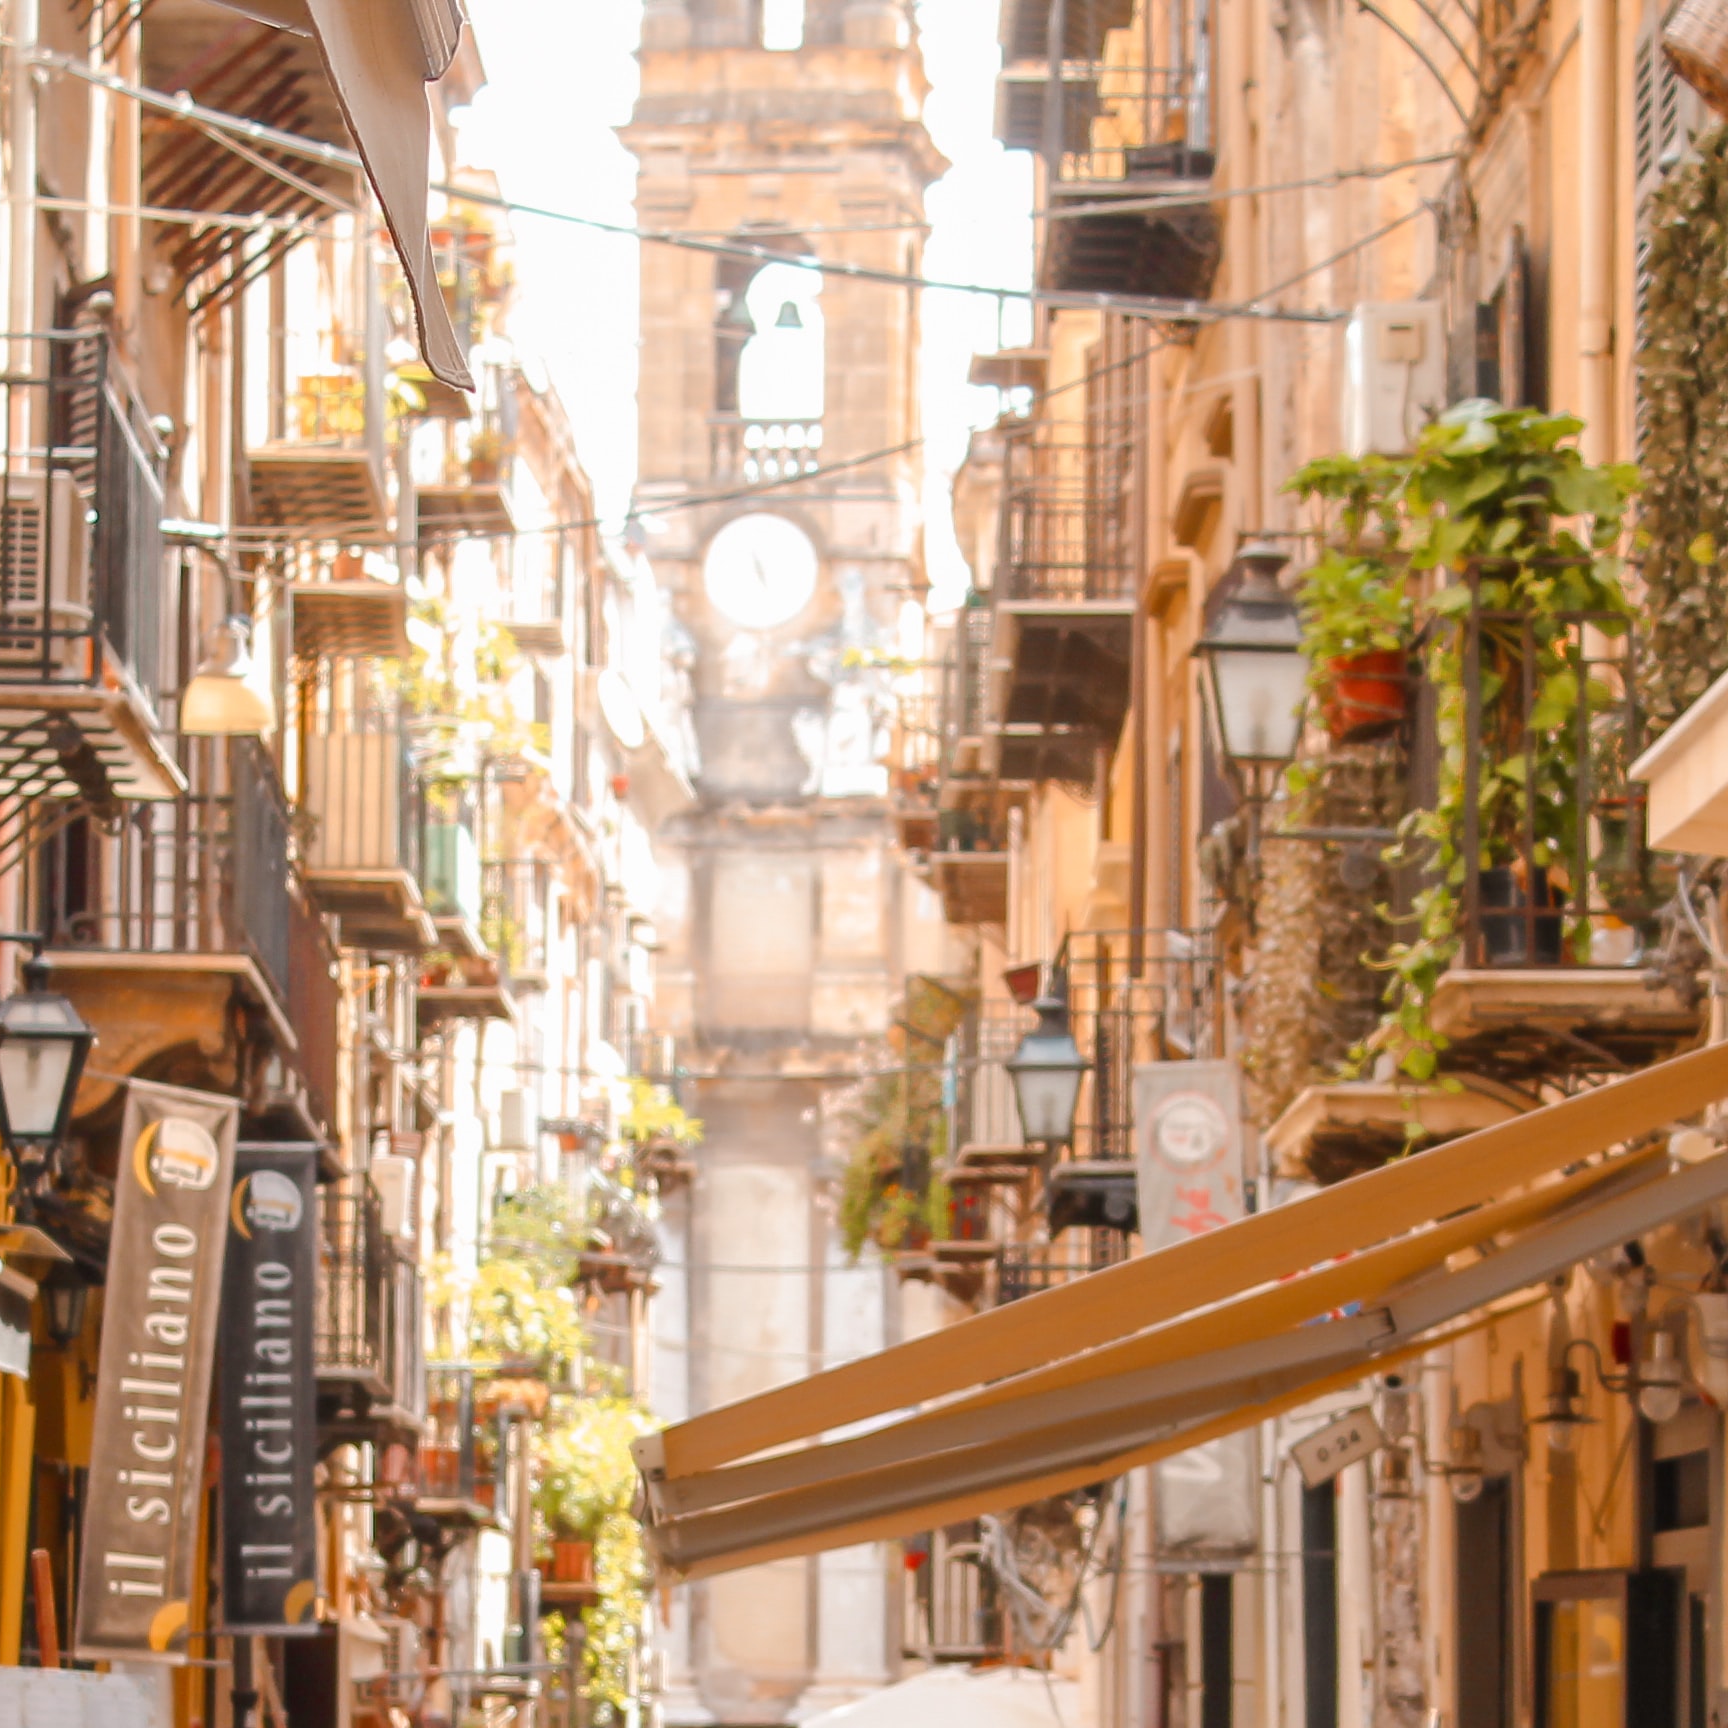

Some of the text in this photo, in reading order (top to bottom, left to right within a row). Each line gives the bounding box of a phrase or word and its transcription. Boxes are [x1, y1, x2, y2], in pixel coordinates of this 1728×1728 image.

[104, 1222, 199, 1598] il siciliano
[240, 1261, 293, 1579] il siciliano
